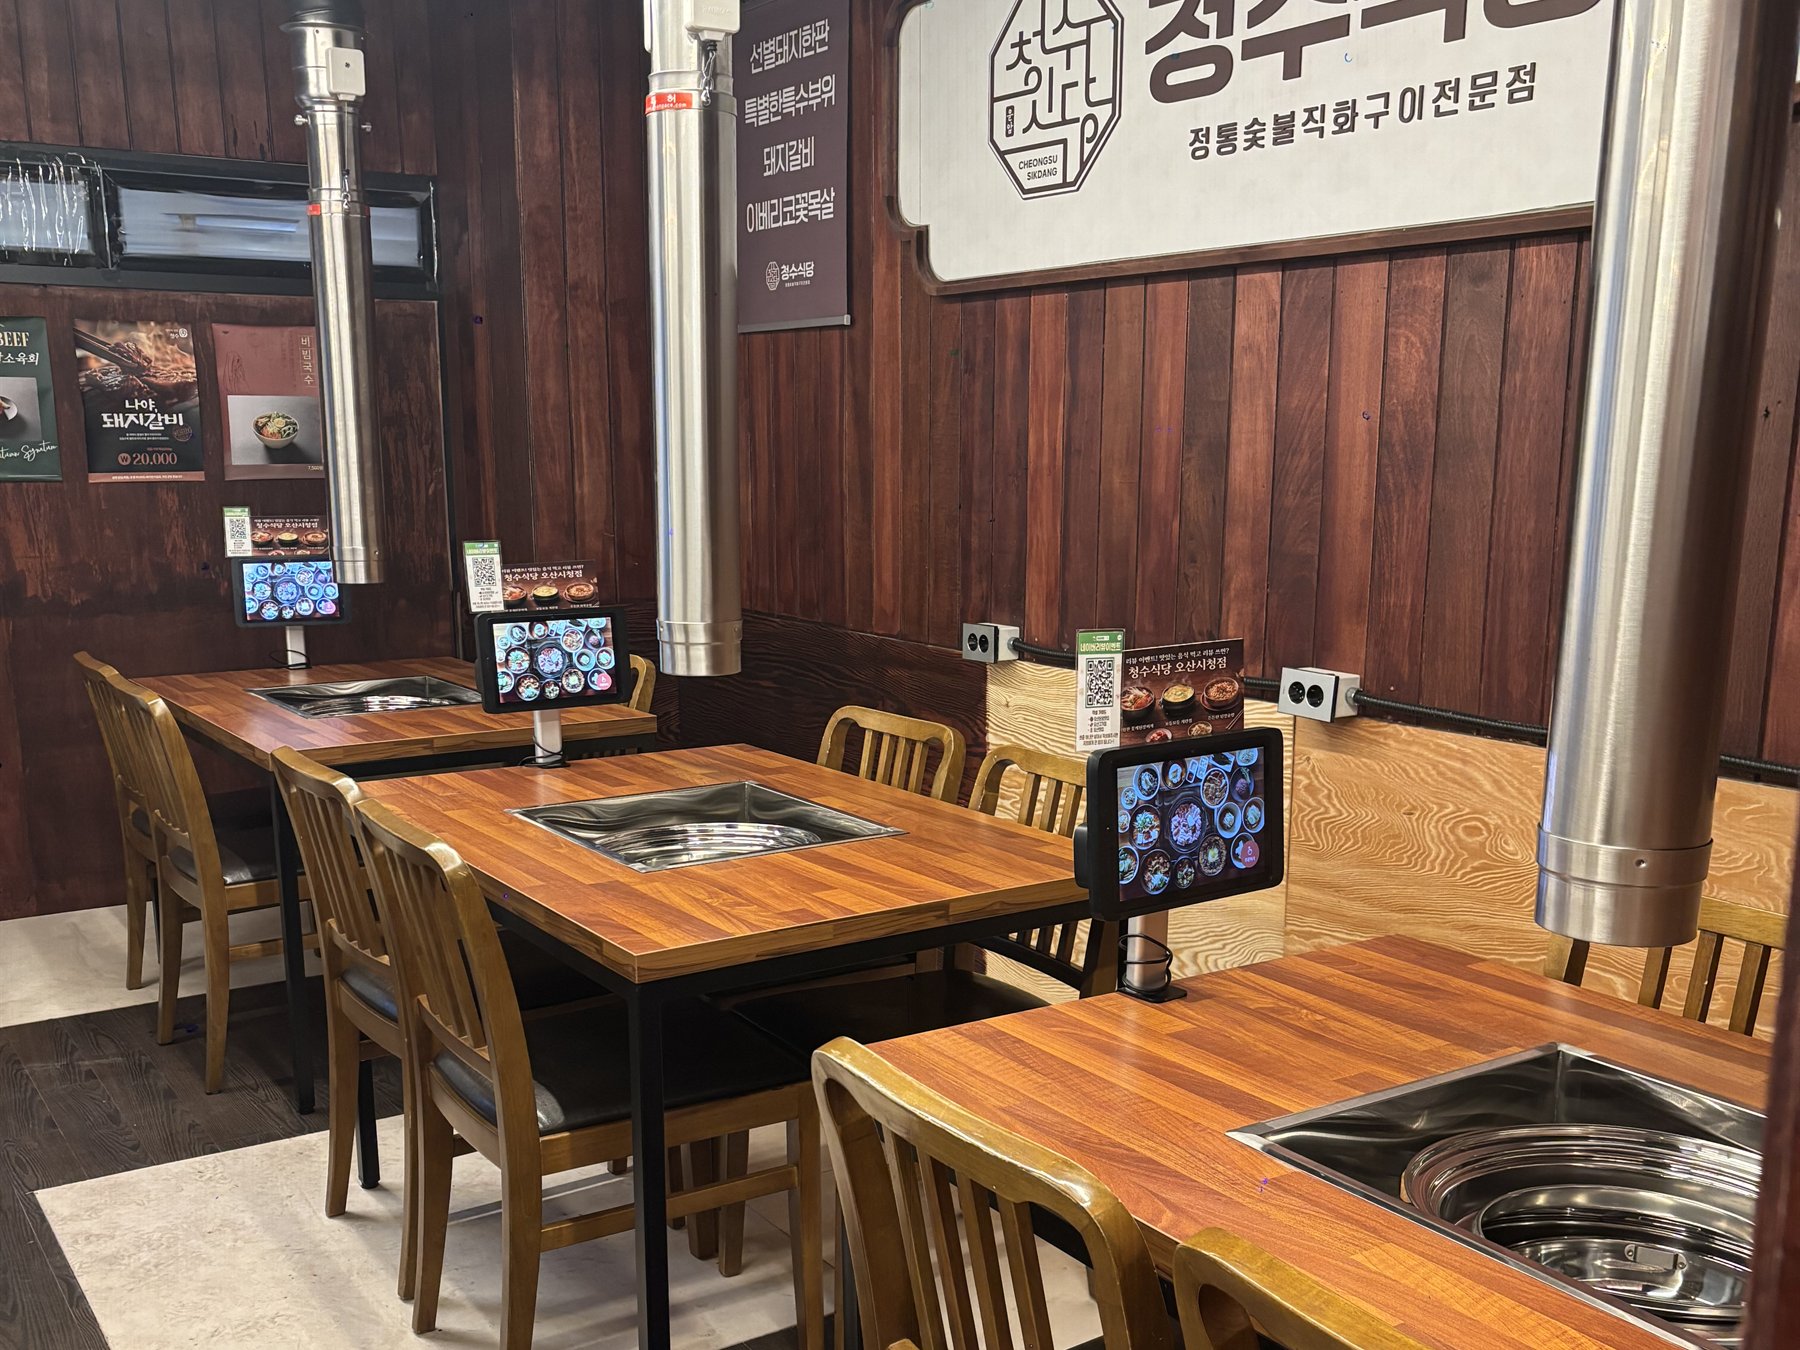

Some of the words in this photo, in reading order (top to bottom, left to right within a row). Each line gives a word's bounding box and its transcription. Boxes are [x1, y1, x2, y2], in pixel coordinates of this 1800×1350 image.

[750, 18, 830, 74] 선별돼지한판
[744, 74, 836, 128] 특별한특수부위
[763, 136, 815, 177] 돼지갈비
[1018, 154, 1058, 170] CHEONGSU
[1027, 167, 1057, 180] SIKDANG
[746, 187, 836, 233] 이베리코꽃목살
[781, 261, 814, 281] 청수식당
[0, 351, 39, 366] 소육회
[125, 398, 158, 413] 나야,
[101, 412, 184, 430] 돼지갈비
[1128, 662, 1172, 679] 청수식당
[1174, 656, 1227, 673] 오산시청점
